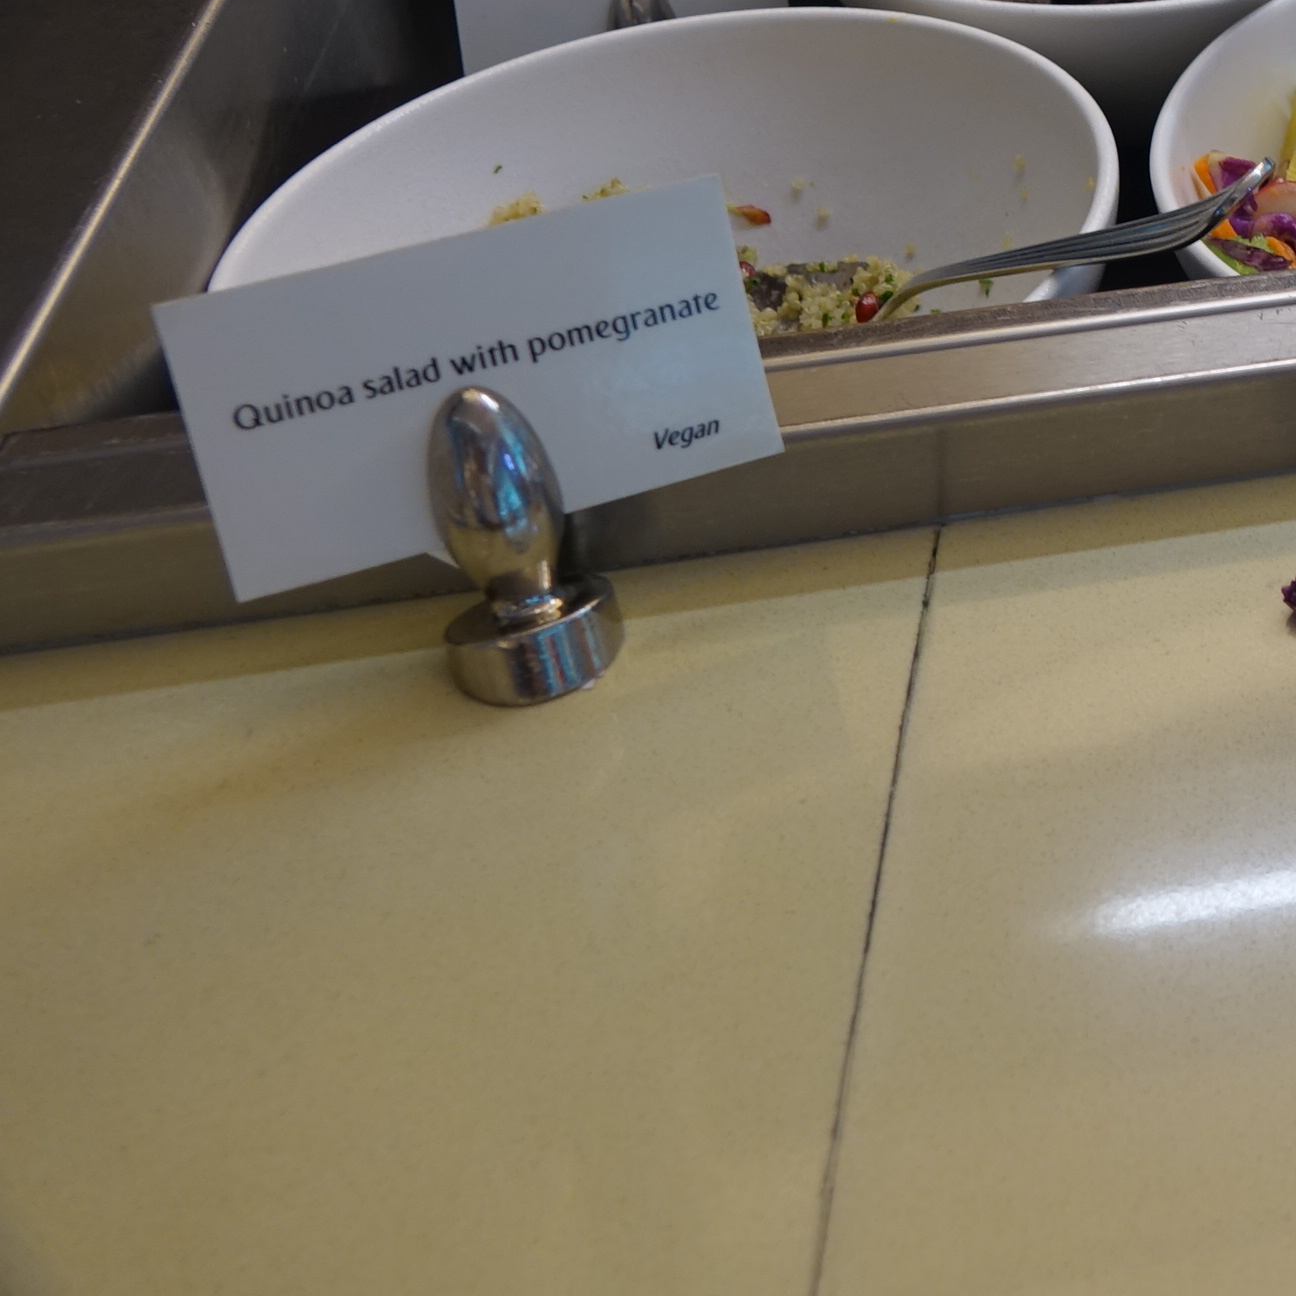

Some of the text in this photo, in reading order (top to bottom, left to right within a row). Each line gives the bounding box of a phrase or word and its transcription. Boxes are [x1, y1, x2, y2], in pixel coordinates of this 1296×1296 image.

[231, 289, 721, 432] Quinoa salad with pomegranate
[652, 416, 721, 452] Vegan
